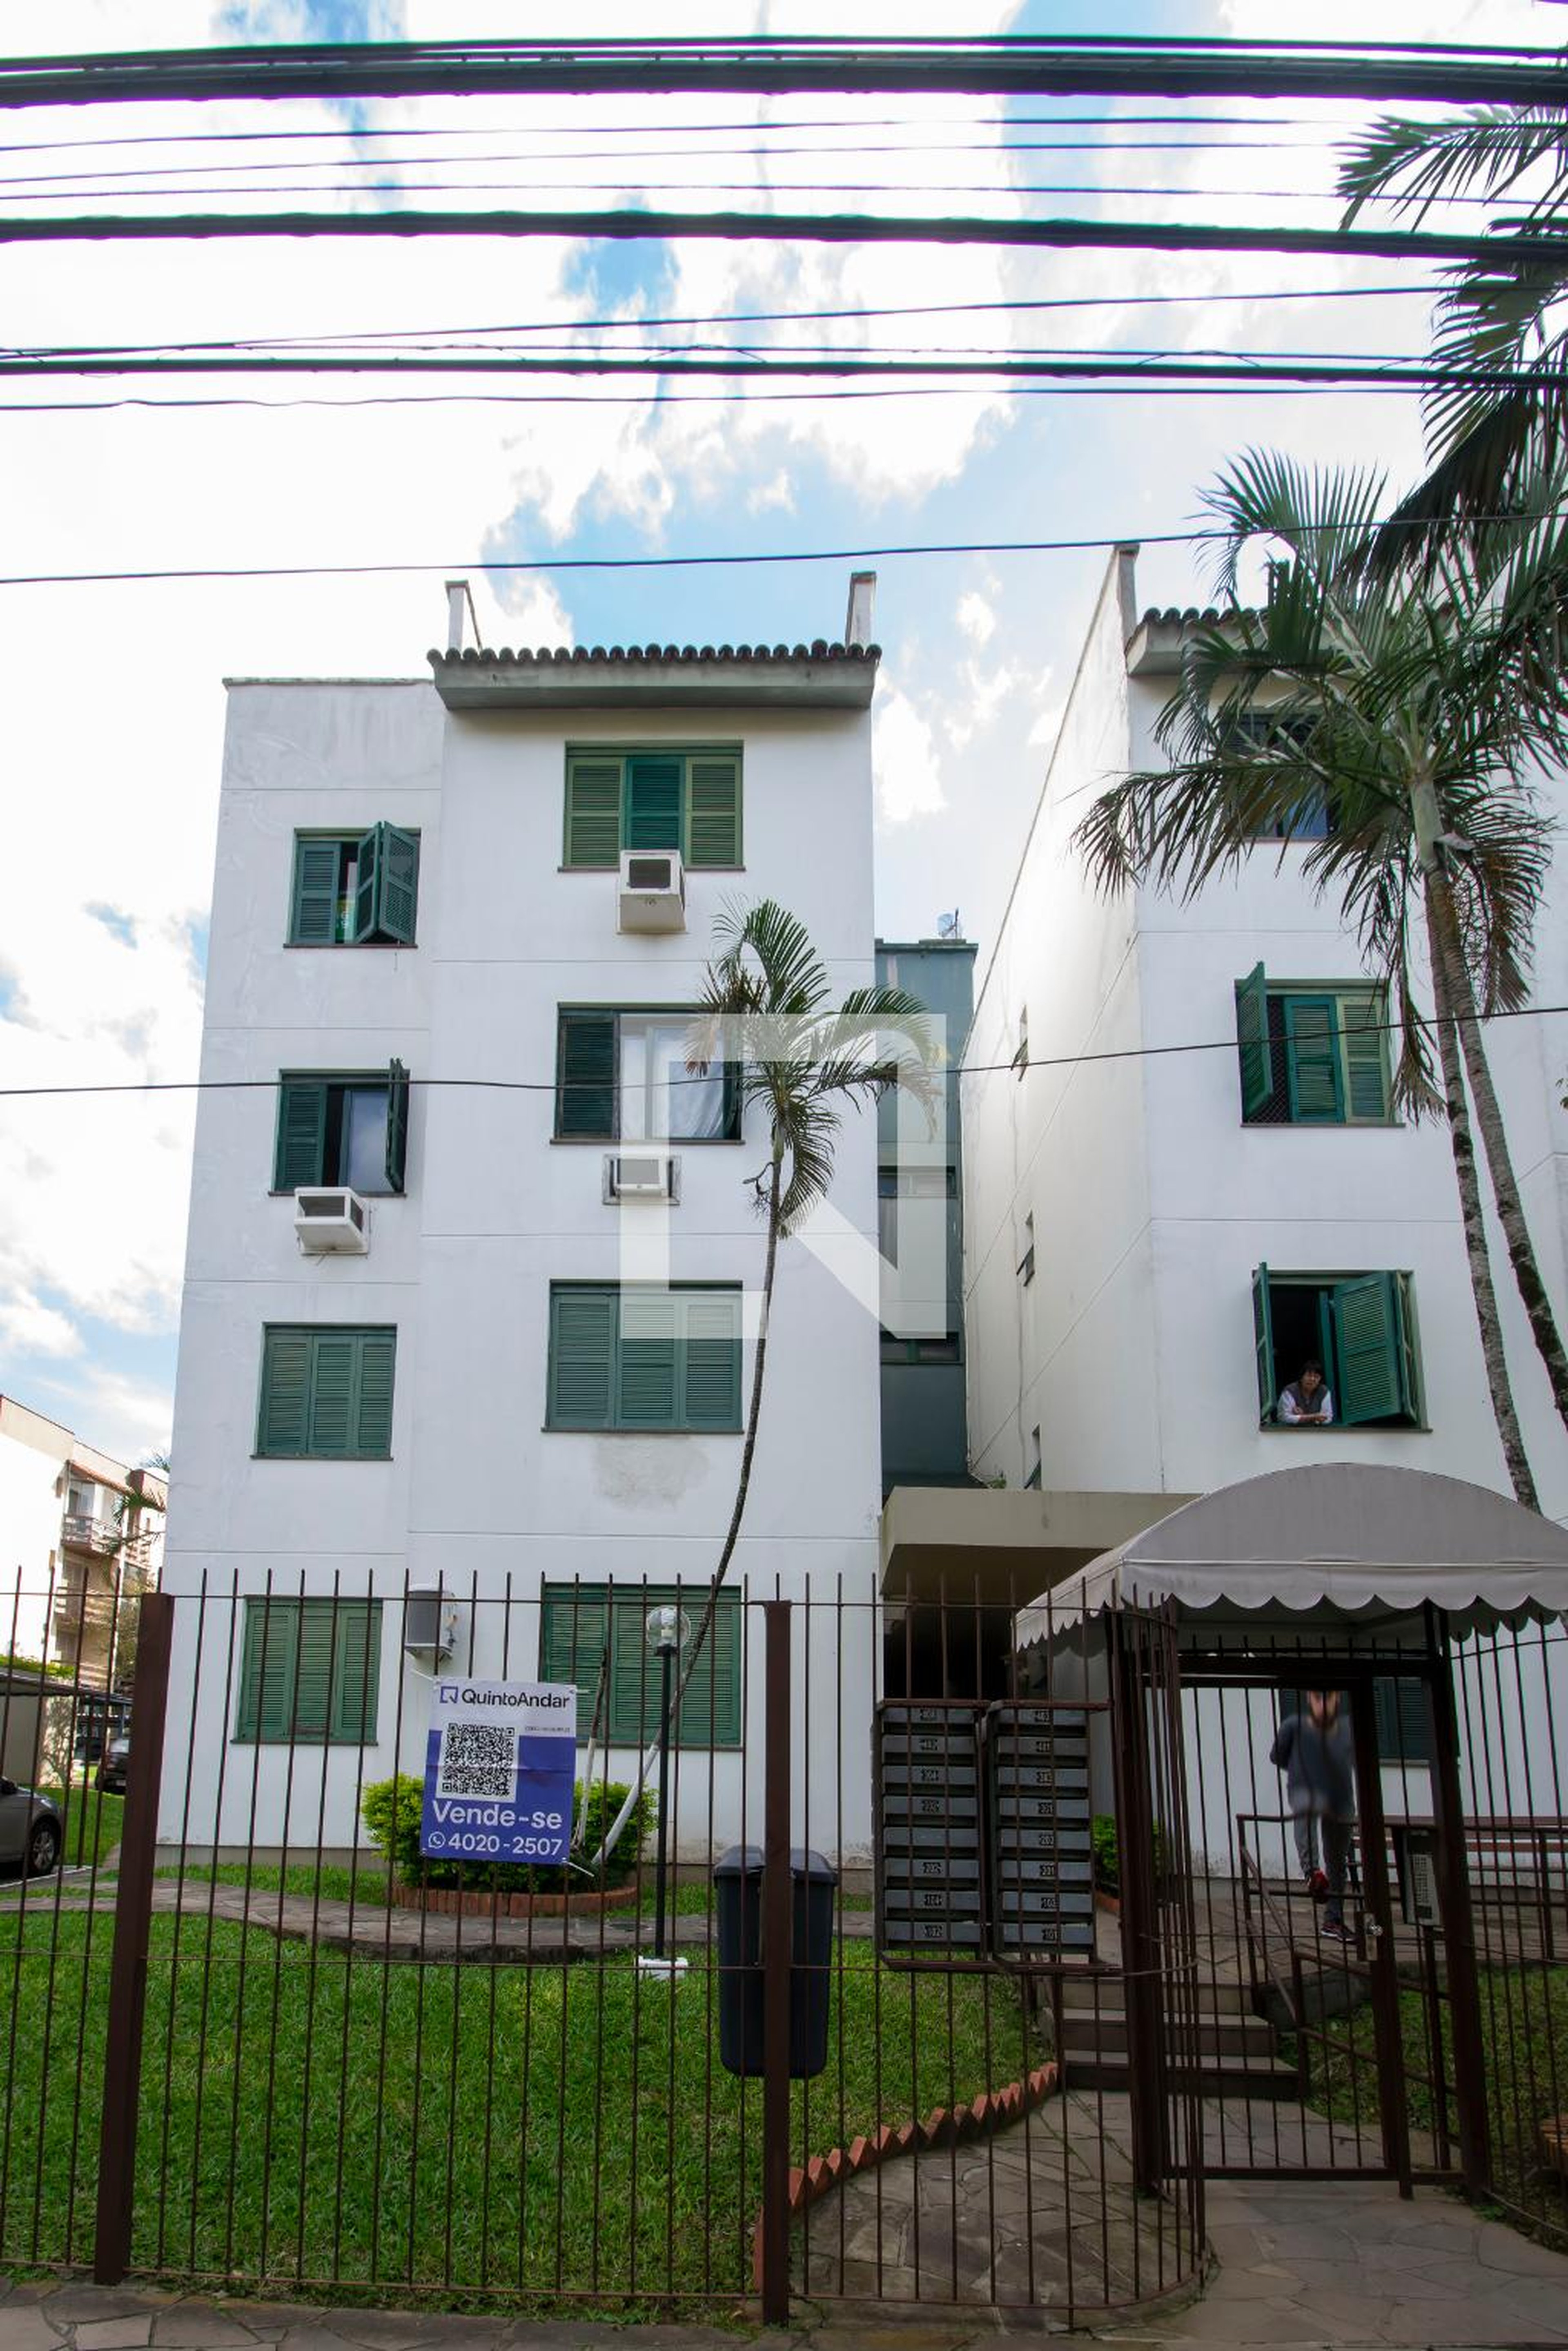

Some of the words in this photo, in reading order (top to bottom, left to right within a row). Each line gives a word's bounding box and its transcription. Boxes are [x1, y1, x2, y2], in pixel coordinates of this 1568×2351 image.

[462, 1688, 570, 1708] QuintoAndar
[432, 1800, 562, 1829] Vende-se
[448, 1833, 562, 1856] 4020-2507
